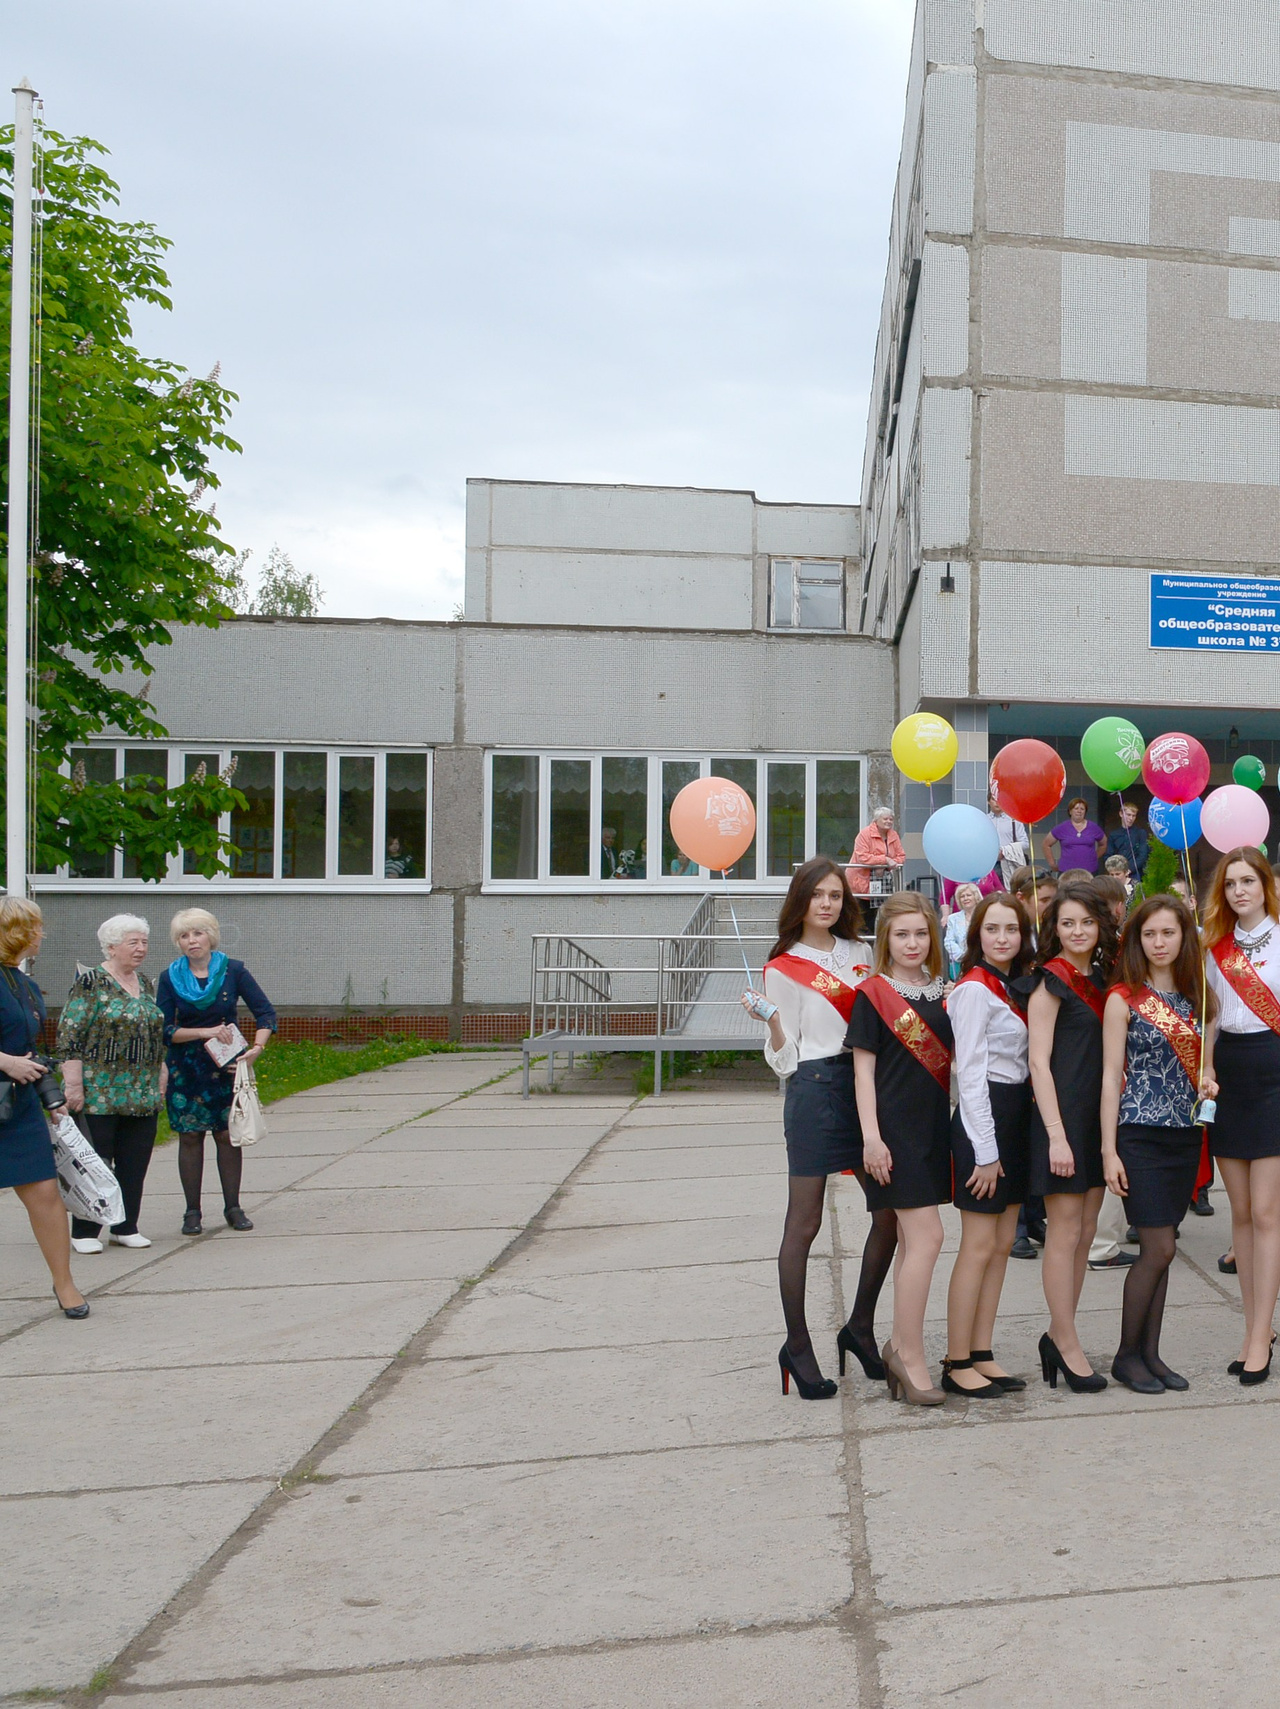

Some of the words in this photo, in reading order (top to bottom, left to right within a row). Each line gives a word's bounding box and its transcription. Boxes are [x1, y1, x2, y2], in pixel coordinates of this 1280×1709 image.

[1163, 579, 1228, 590] Муниципальное
[1217, 590, 1267, 599] учреждение
[1197, 636, 1245, 647] школа
[1249, 636, 1266, 647] №
